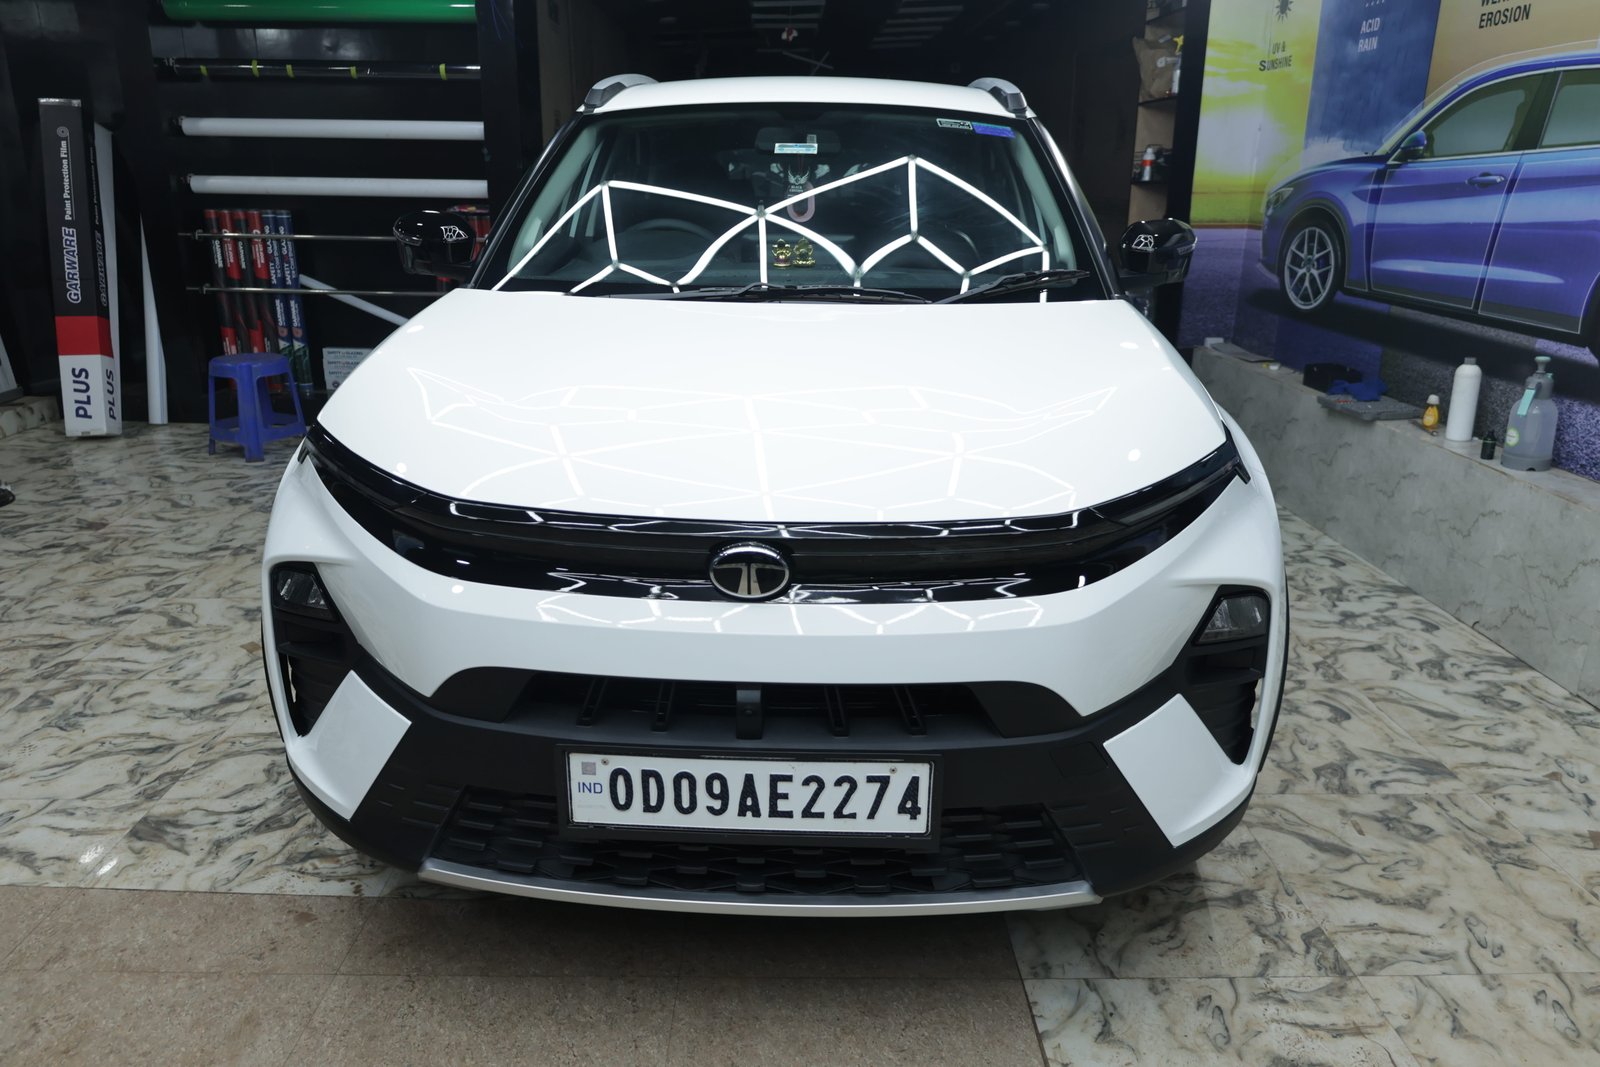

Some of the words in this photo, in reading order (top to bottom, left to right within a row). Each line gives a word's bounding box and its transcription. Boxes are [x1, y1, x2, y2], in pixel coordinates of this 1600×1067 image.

[1360, 17, 1381, 34] ACID
[1479, 3, 1531, 29] EROSION
[1272, 42, 1281, 55] UV
[1357, 36, 1378, 52] RAIN
[1258, 54, 1293, 72] SUNSHINE
[60, 140, 68, 158] Film
[62, 159, 71, 199] Protection
[64, 200, 72, 220] Paint
[264, 225, 273, 254] GLANG
[279, 226, 287, 255] GLANG
[62, 226, 81, 304] GARWARE
[71, 367, 92, 419] PLUS
[106, 369, 117, 420] PLUS
[578, 781, 603, 794] IND
[609, 767, 922, 820] OD09AE22274
